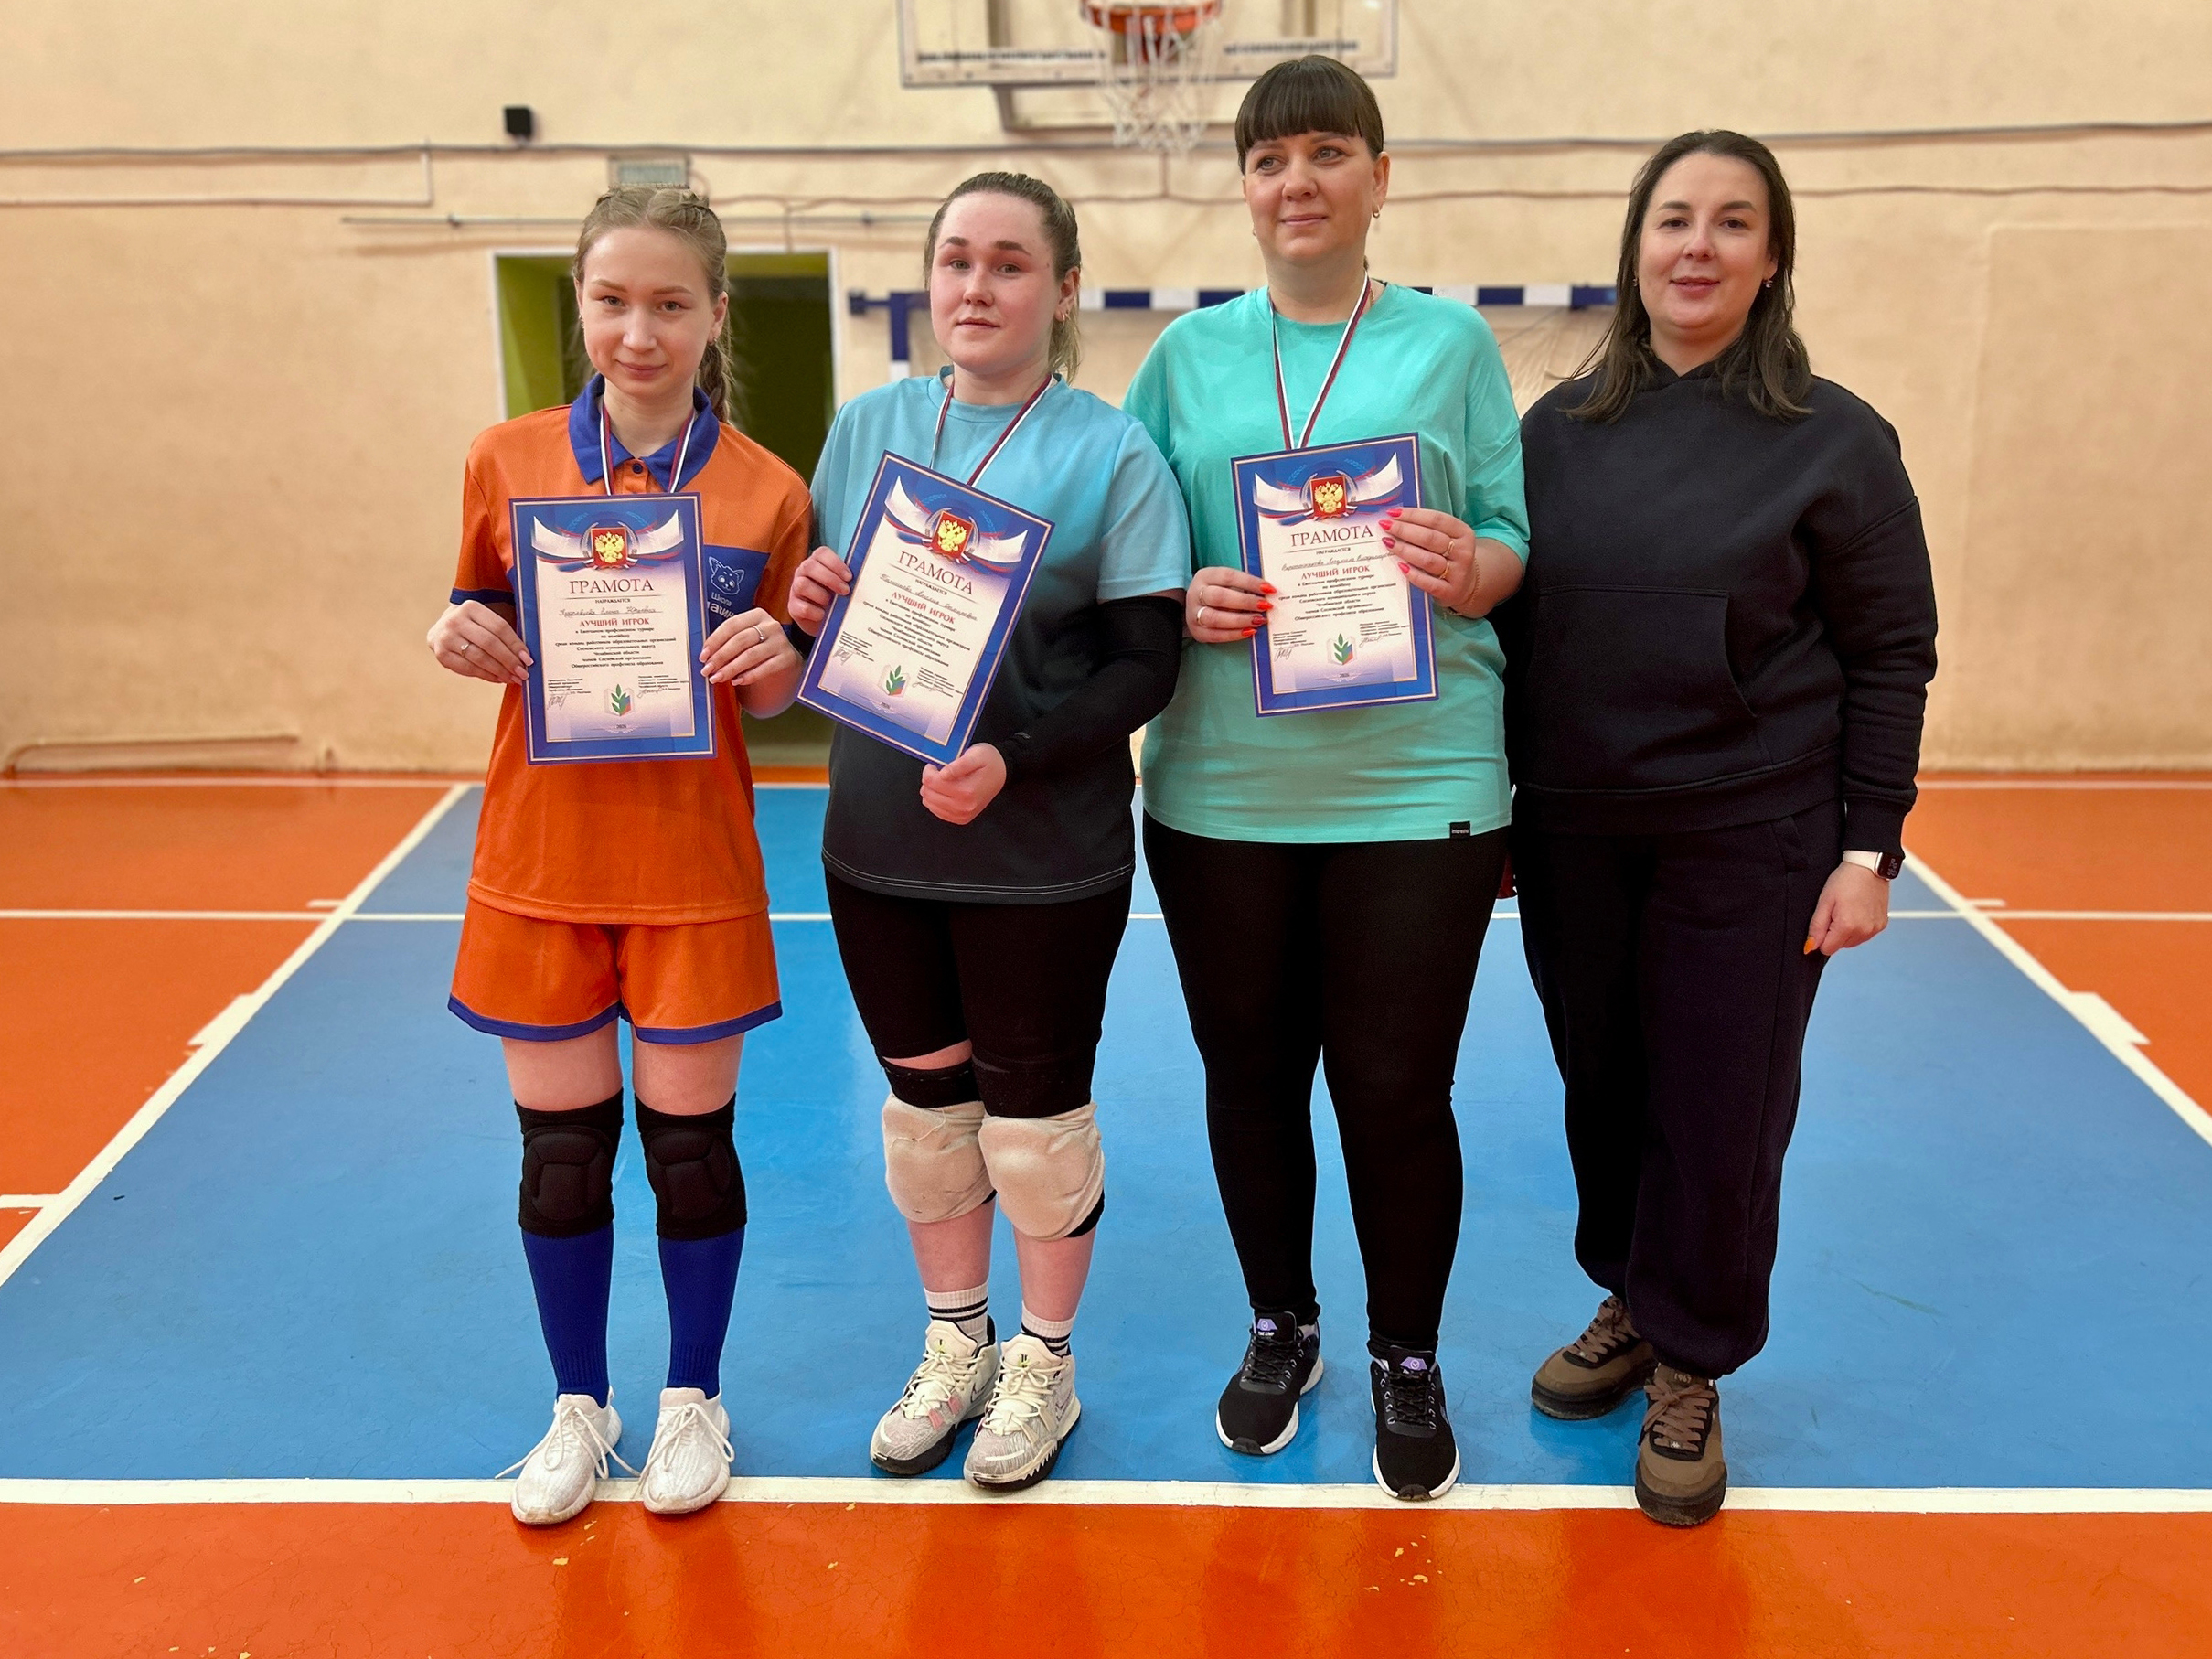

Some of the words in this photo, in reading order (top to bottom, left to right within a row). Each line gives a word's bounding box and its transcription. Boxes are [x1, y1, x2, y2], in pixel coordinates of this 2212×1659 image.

[1290, 523, 1373, 546] ГРАМОТА
[897, 550, 976, 596] ГРАМОТА
[1300, 568, 1338, 579] ЛУЧШИЙ
[1342, 565, 1370, 574] ИГРОК
[569, 577, 654, 594] ГРАМОТА
[711, 592, 732, 606] Школа
[891, 589, 926, 612] ЛУЧШИЙ
[928, 606, 956, 625] ИГРОК
[579, 618, 617, 626] ЛУЧШИЙ
